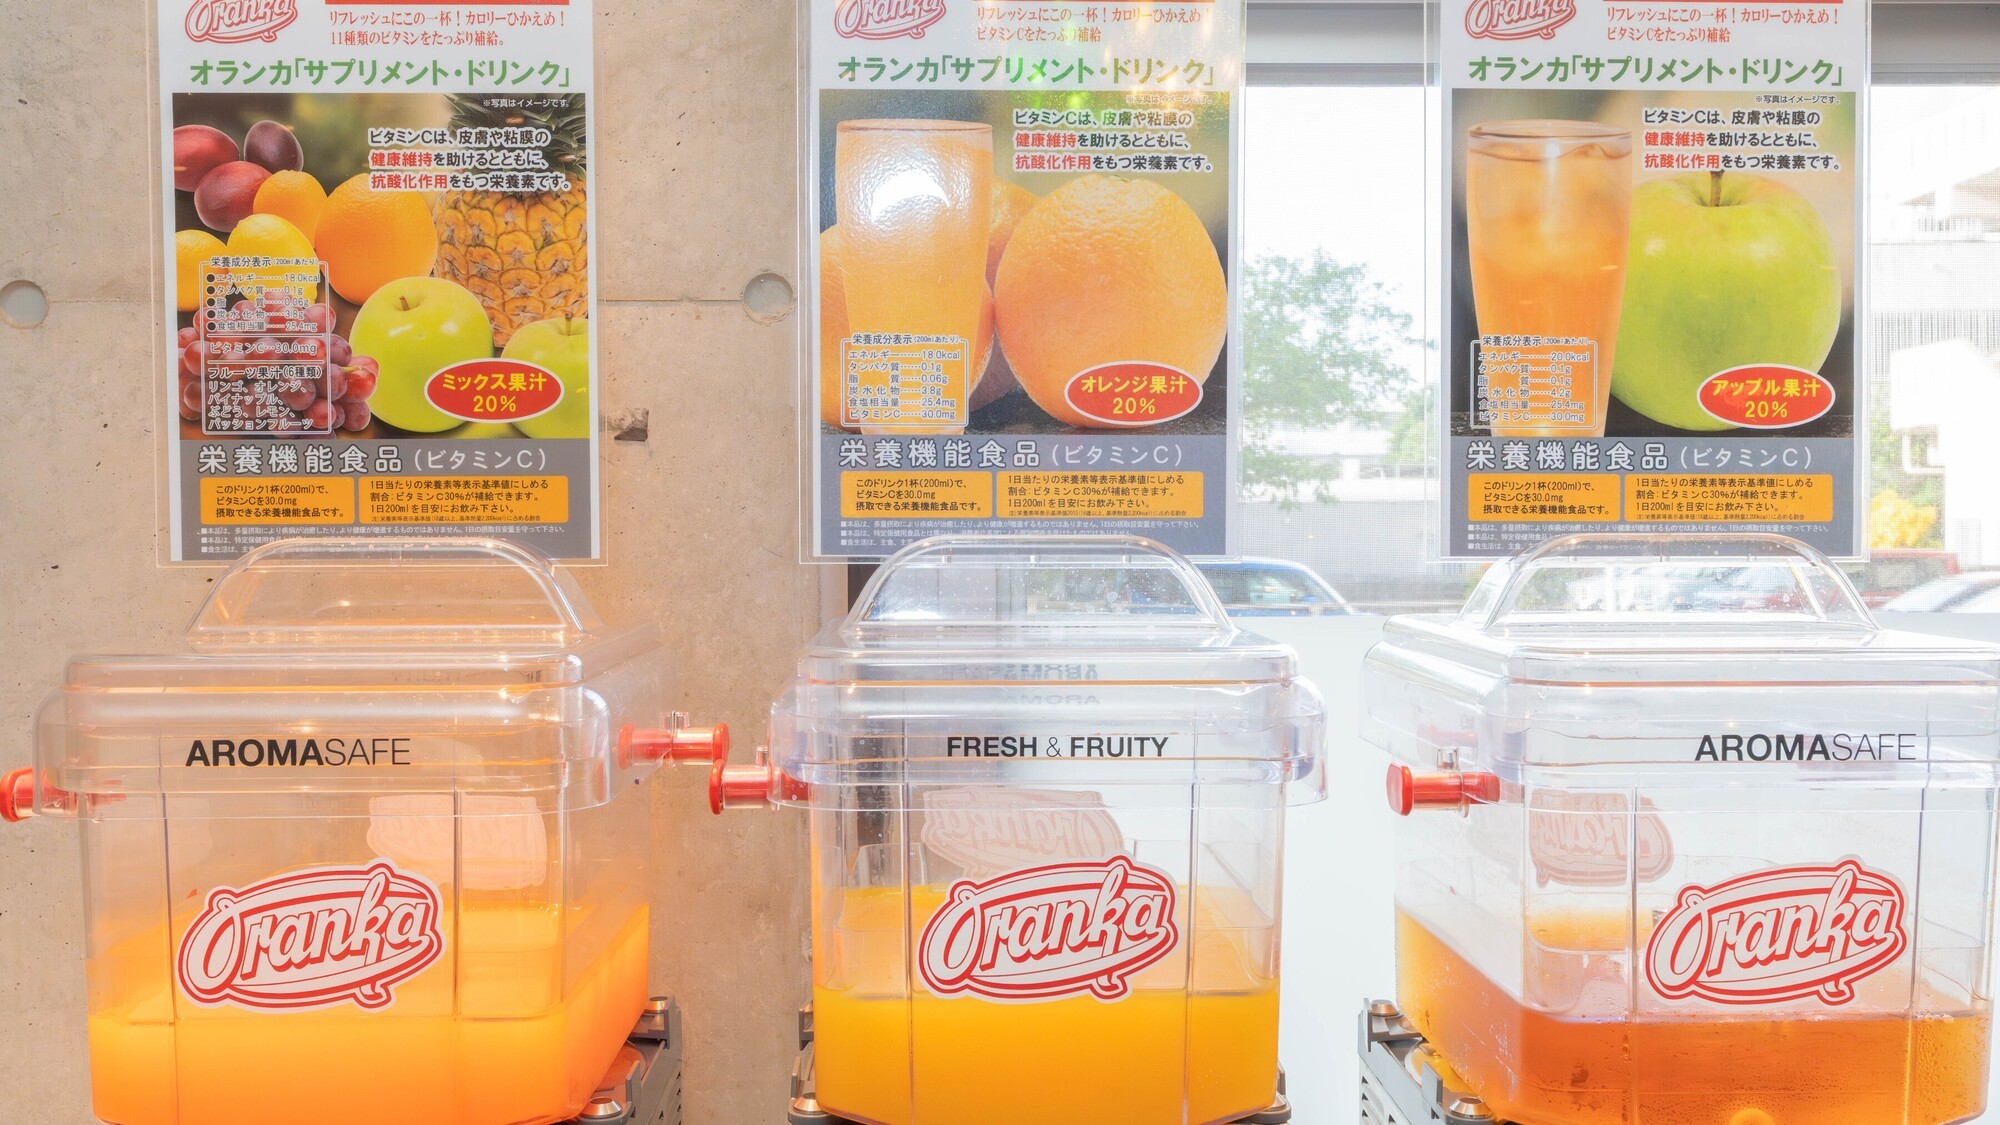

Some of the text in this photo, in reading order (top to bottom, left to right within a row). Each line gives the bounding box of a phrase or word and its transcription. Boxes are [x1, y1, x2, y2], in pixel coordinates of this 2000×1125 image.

[330, 30, 504, 46] 11種類のビタミンをたっぷり補給。
[1607, 26, 1730, 42] ビタミンCをたっぷり補給
[190, 58, 570, 87] オランカ「サプリメント・ドリンク」
[838, 55, 1215, 86] オランカ「サプリメント・ドリンク」
[1468, 55, 1842, 86] オランカ「サプリメント・ドリンク」
[483, 98, 570, 108] ※写真はイメージです。
[1755, 95, 1840, 104] ※写真はイメージです。
[1015, 111, 1191, 126] ビタミンCは、皮膚や粘膜の
[1644, 110, 1820, 125] ビタミンCは、皮膚や粘膜の
[370, 130, 549, 145] ビタミンCは、皮膚や粘膜の
[1016, 133, 1190, 148] 健康維持を助けるとともに、
[1644, 132, 1818, 147] 健康維持を助けるとともに、
[371, 152, 548, 167] 健康維持を助けるとともに、
[1015, 154, 1212, 170] 抗酸化作用をもつ栄養素です。
[1644, 154, 1840, 169] 抗酸化作用をもつ栄養素です。
[371, 174, 569, 189] 抗酸化作用をもつ栄養素です。
[442, 372, 547, 392] ミックス果汁
[1081, 375, 1188, 395] オレンジ果汁
[1712, 378, 1821, 397] アップル果汁
[472, 395, 517, 413] 20%
[1112, 398, 1155, 414] 20%
[1744, 401, 1788, 418] 20%
[370, 480, 548, 490] 1日当たりの栄養素等表示基準値にしめる
[856, 478, 967, 489] このドリンク1杯(200ml)で、
[1008, 475, 1184, 485] 1日当たりの栄養素等表示基準値にしめる
[1484, 481, 1595, 492] このドリンク1杯(200ml)で、
[1636, 478, 1813, 488] 1日当たりの栄養素等表示基準値にしめる
[215, 484, 328, 495] このドリンク1杯(200ml)で、
[856, 490, 936, 500] ビタミンCを30.0mg
[216, 496, 297, 506] ビタミンCを30.0mg
[1009, 498, 1150, 508] 1日200mlを目安にお飲み下さい。
[1484, 493, 1563, 503] ビタミンCを30.0mg
[215, 507, 344, 518] 摂取できる栄養機能食品です。
[371, 504, 514, 513] 1日200mlを目安にお飲み下さい。
[856, 501, 983, 511] 摂取できる栄養機能食品です。
[1483, 504, 1610, 514] 摂取できる栄養機能食品です。
[1636, 502, 1779, 512] 1日200mlを目安にお飲み下さい。
[186, 738, 411, 767] AROMASAFE
[947, 736, 1168, 758] FRESH & FRUITY
[1694, 733, 1917, 762] AROMASAFE
[184, 867, 436, 996] Oranka
[923, 862, 1176, 988] Oranka
[1648, 866, 1900, 993] Oranka
